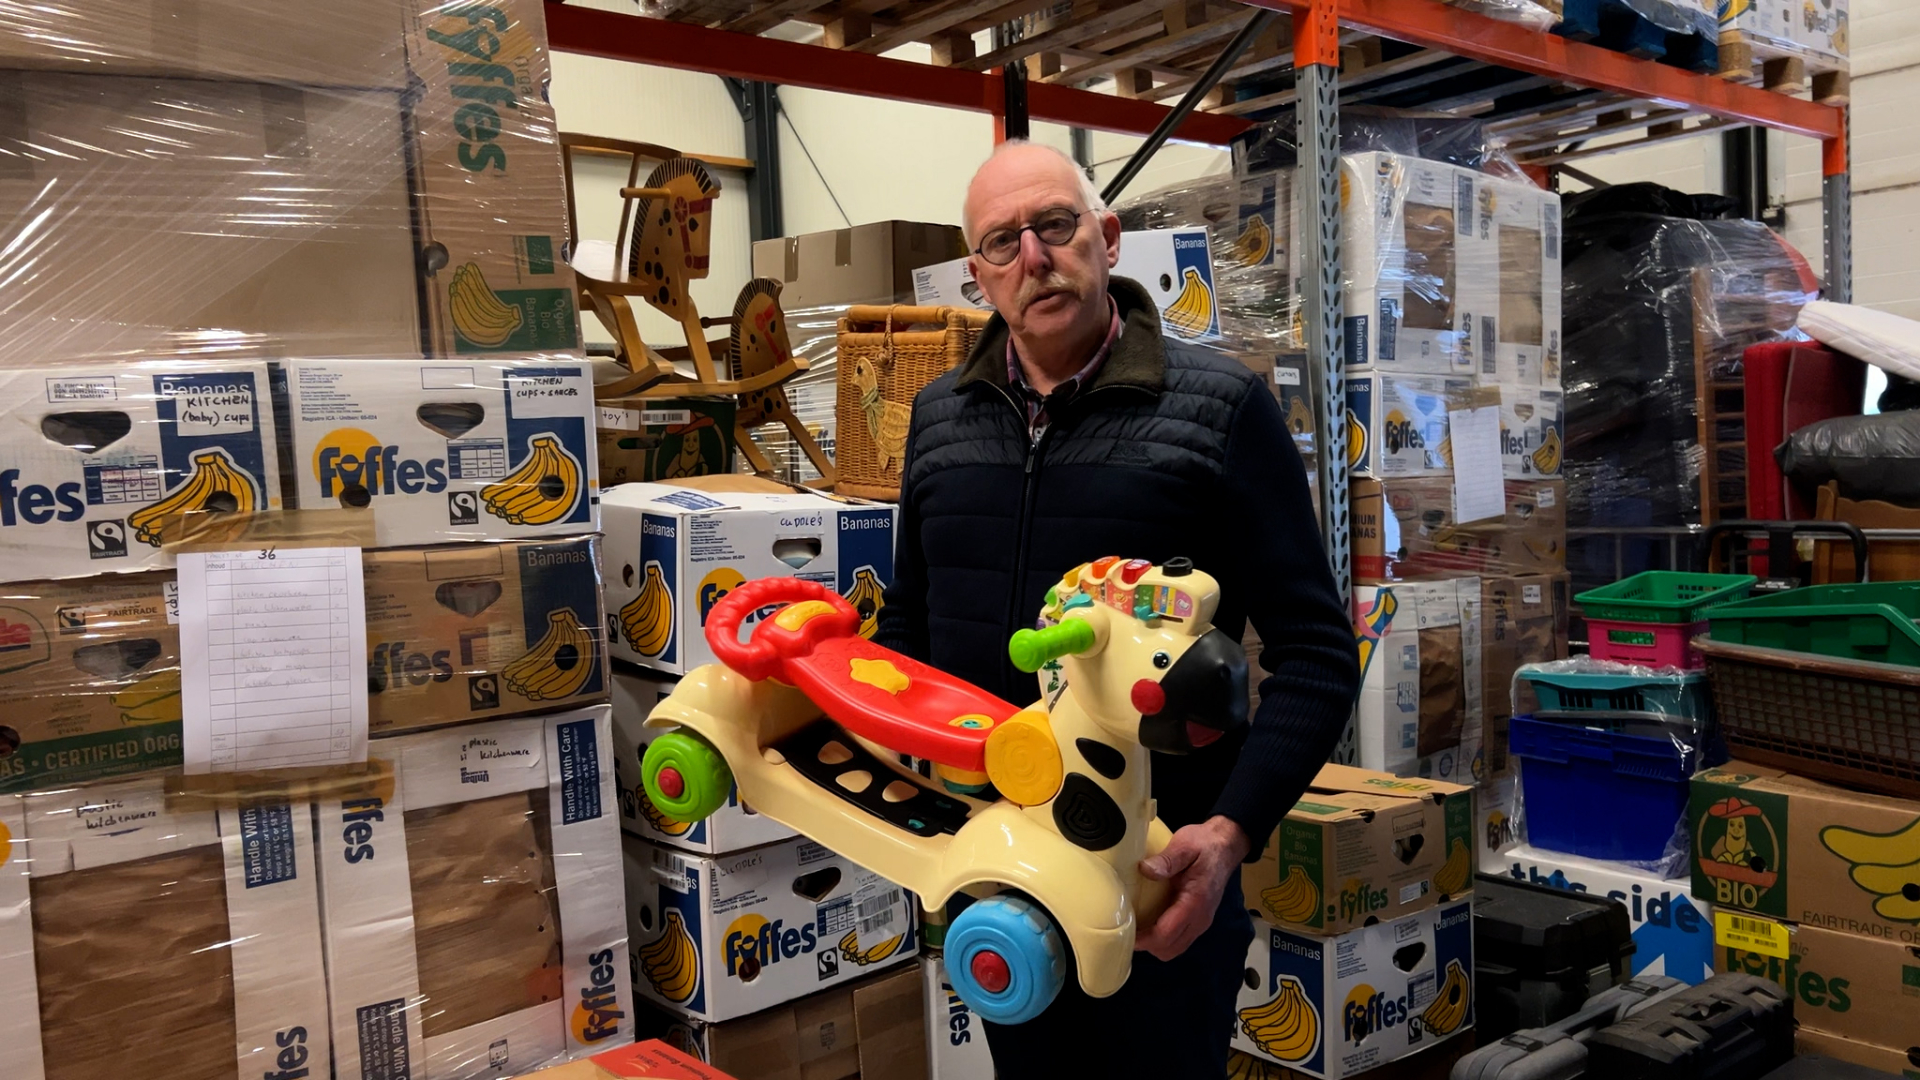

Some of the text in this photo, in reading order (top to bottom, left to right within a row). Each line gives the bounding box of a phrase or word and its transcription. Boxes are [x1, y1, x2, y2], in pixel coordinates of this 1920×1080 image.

[1175, 235, 1206, 250] Bananas
[540, 311, 551, 329] Bio
[1355, 317, 1366, 362] Bananas
[1346, 383, 1369, 393] anas
[186, 394, 249, 408] KITCHEN
[1501, 428, 1524, 456] ffes
[643, 518, 675, 538] Bananas
[840, 515, 891, 531] Bananas
[258, 545, 276, 560] 36
[527, 549, 586, 567] Bananas
[108, 606, 158, 617] FAIRTRADE
[374, 641, 454, 689] ffes
[469, 737, 498, 748] plastic
[45, 740, 139, 771] CERTIFIED
[561, 727, 576, 821] Handle With Care
[1286, 826, 1317, 841] Organic
[244, 809, 262, 884] Handle With
[1284, 851, 1318, 866] Bananas
[1716, 879, 1758, 909] BIO
[1803, 910, 1893, 939] FAIRTRADE
[1272, 934, 1321, 961] Bananas
[582, 948, 625, 1042] fyffes
[389, 1002, 406, 1073] Handle With
